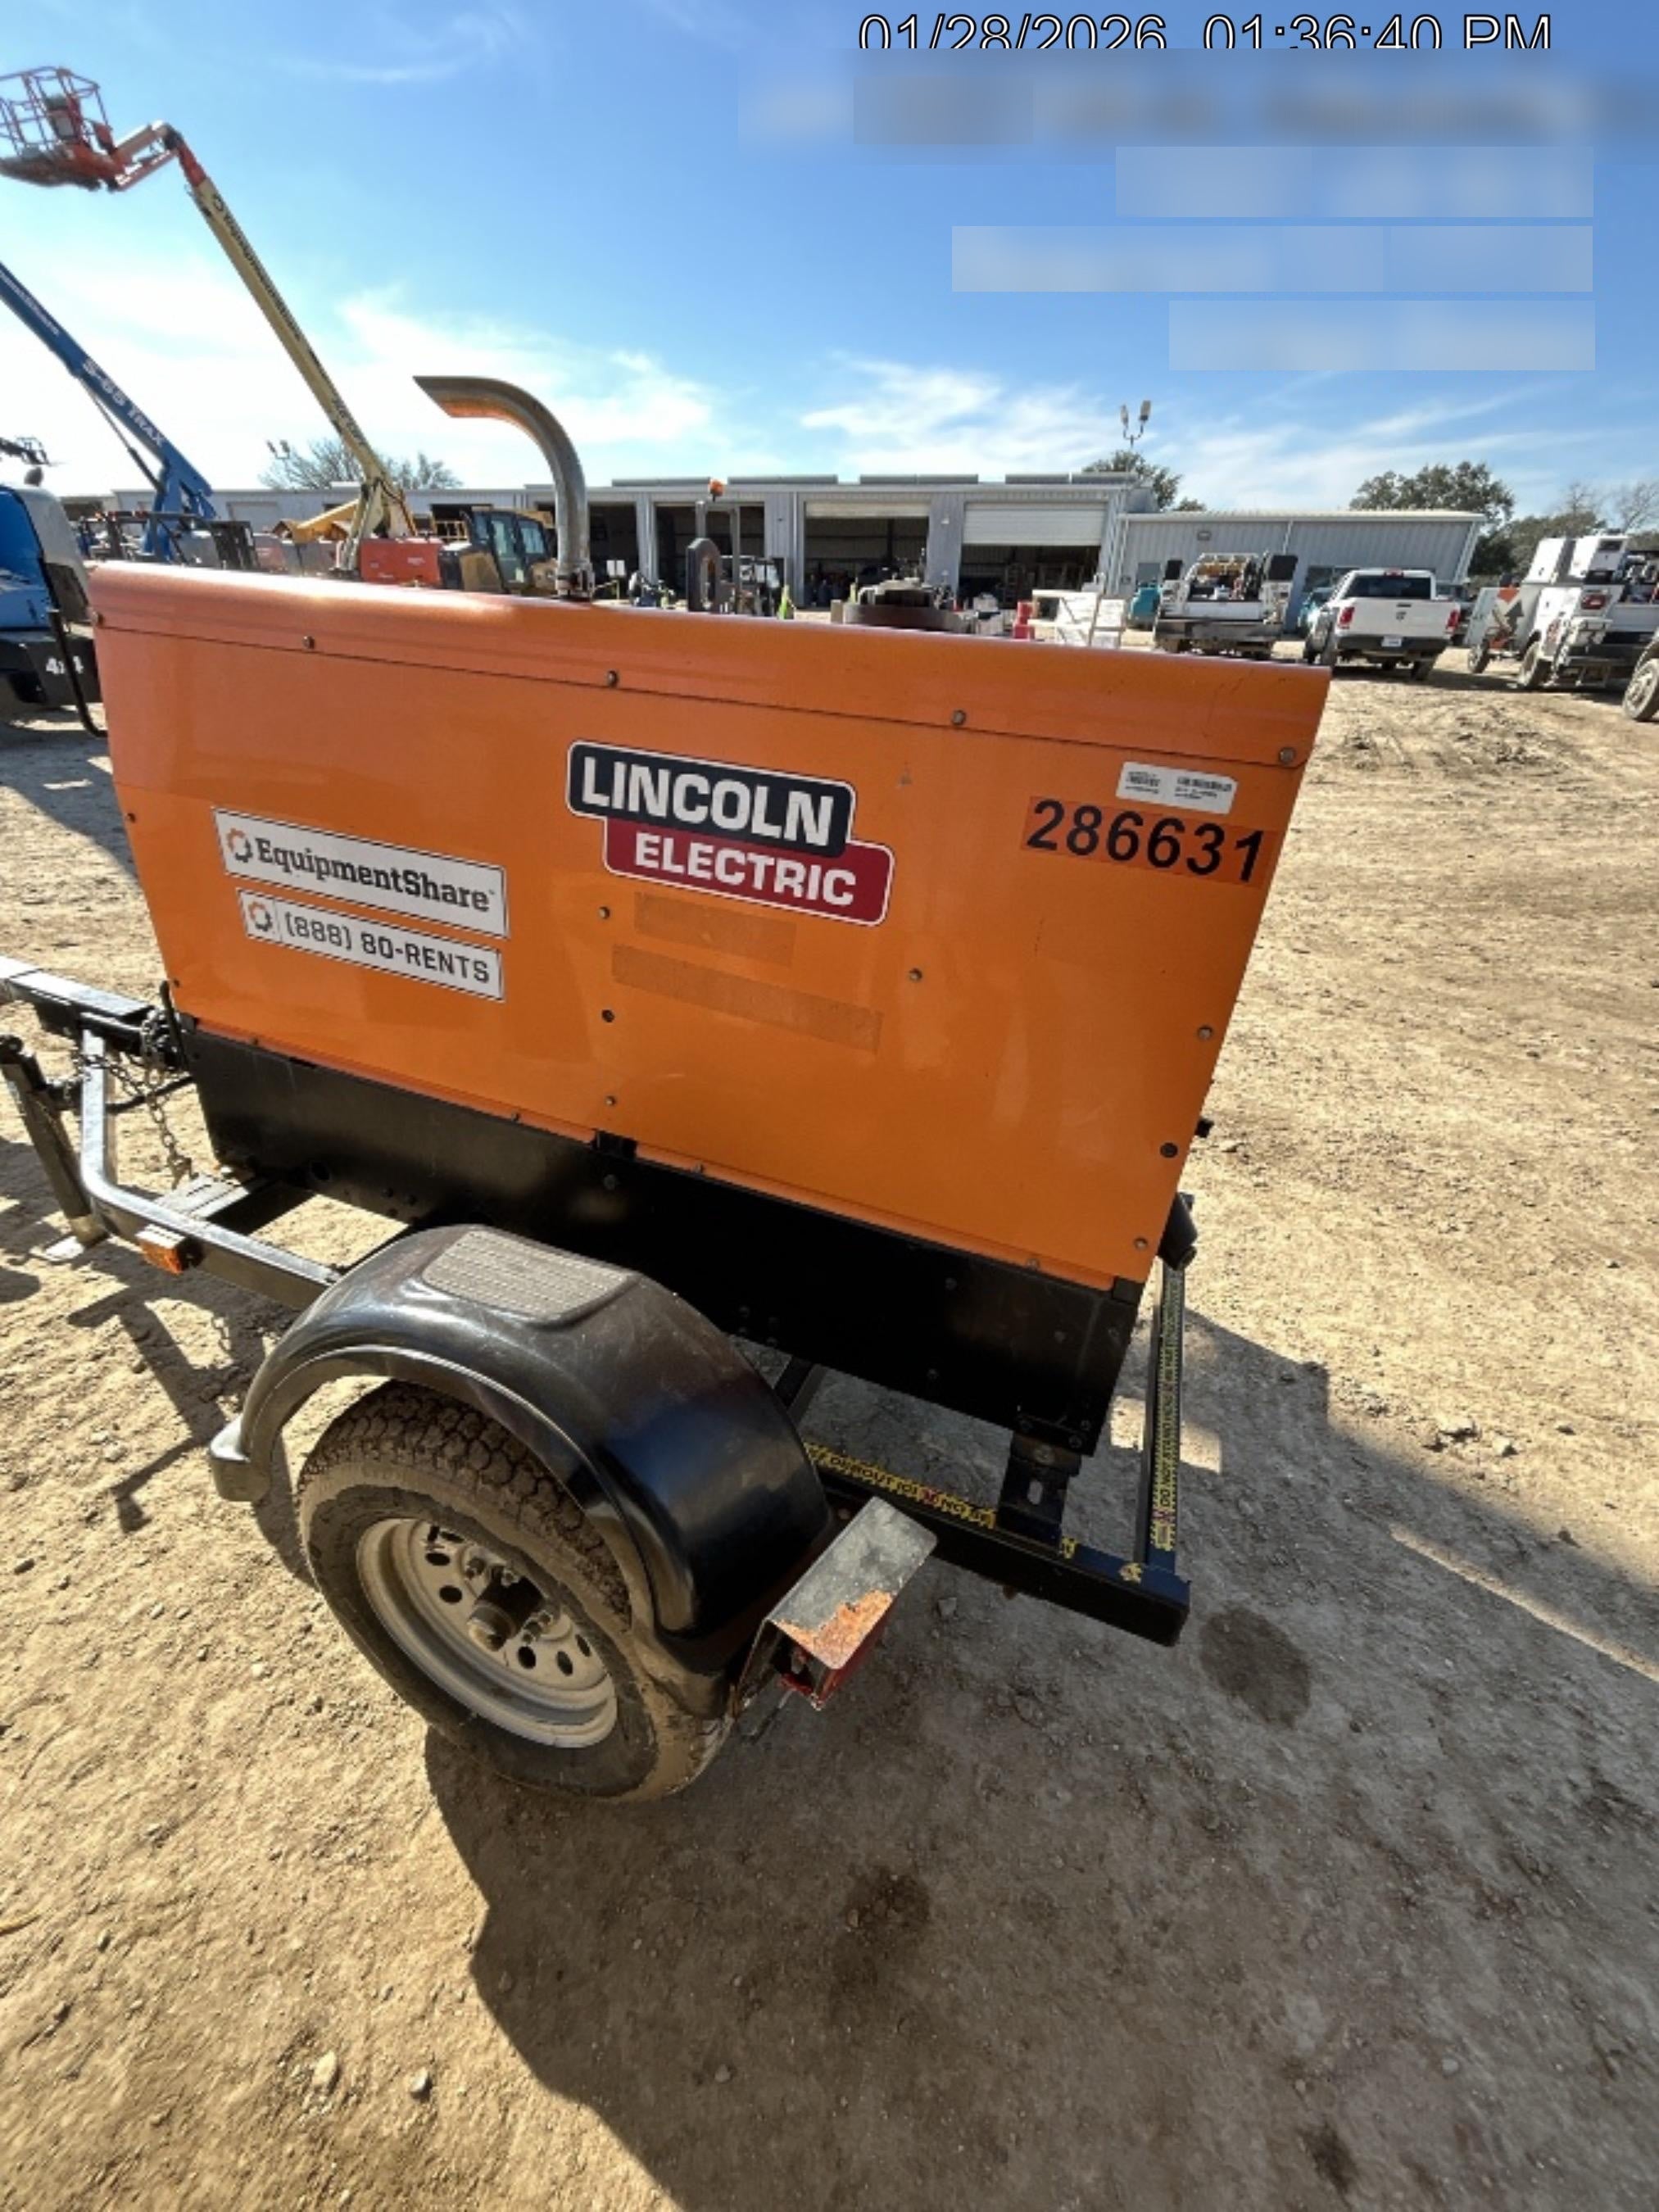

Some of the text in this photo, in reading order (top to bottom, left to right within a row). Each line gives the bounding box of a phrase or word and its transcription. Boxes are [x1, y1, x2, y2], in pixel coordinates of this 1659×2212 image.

[127, 404, 165, 447] TRAX
[582, 756, 834, 846] LINCOLN
[255, 837, 491, 913] EquipmentShare
[635, 832, 857, 907] ELECTRIC
[1027, 799, 1264, 882] 286631
[284, 911, 490, 985] (888) 80-RENTS
